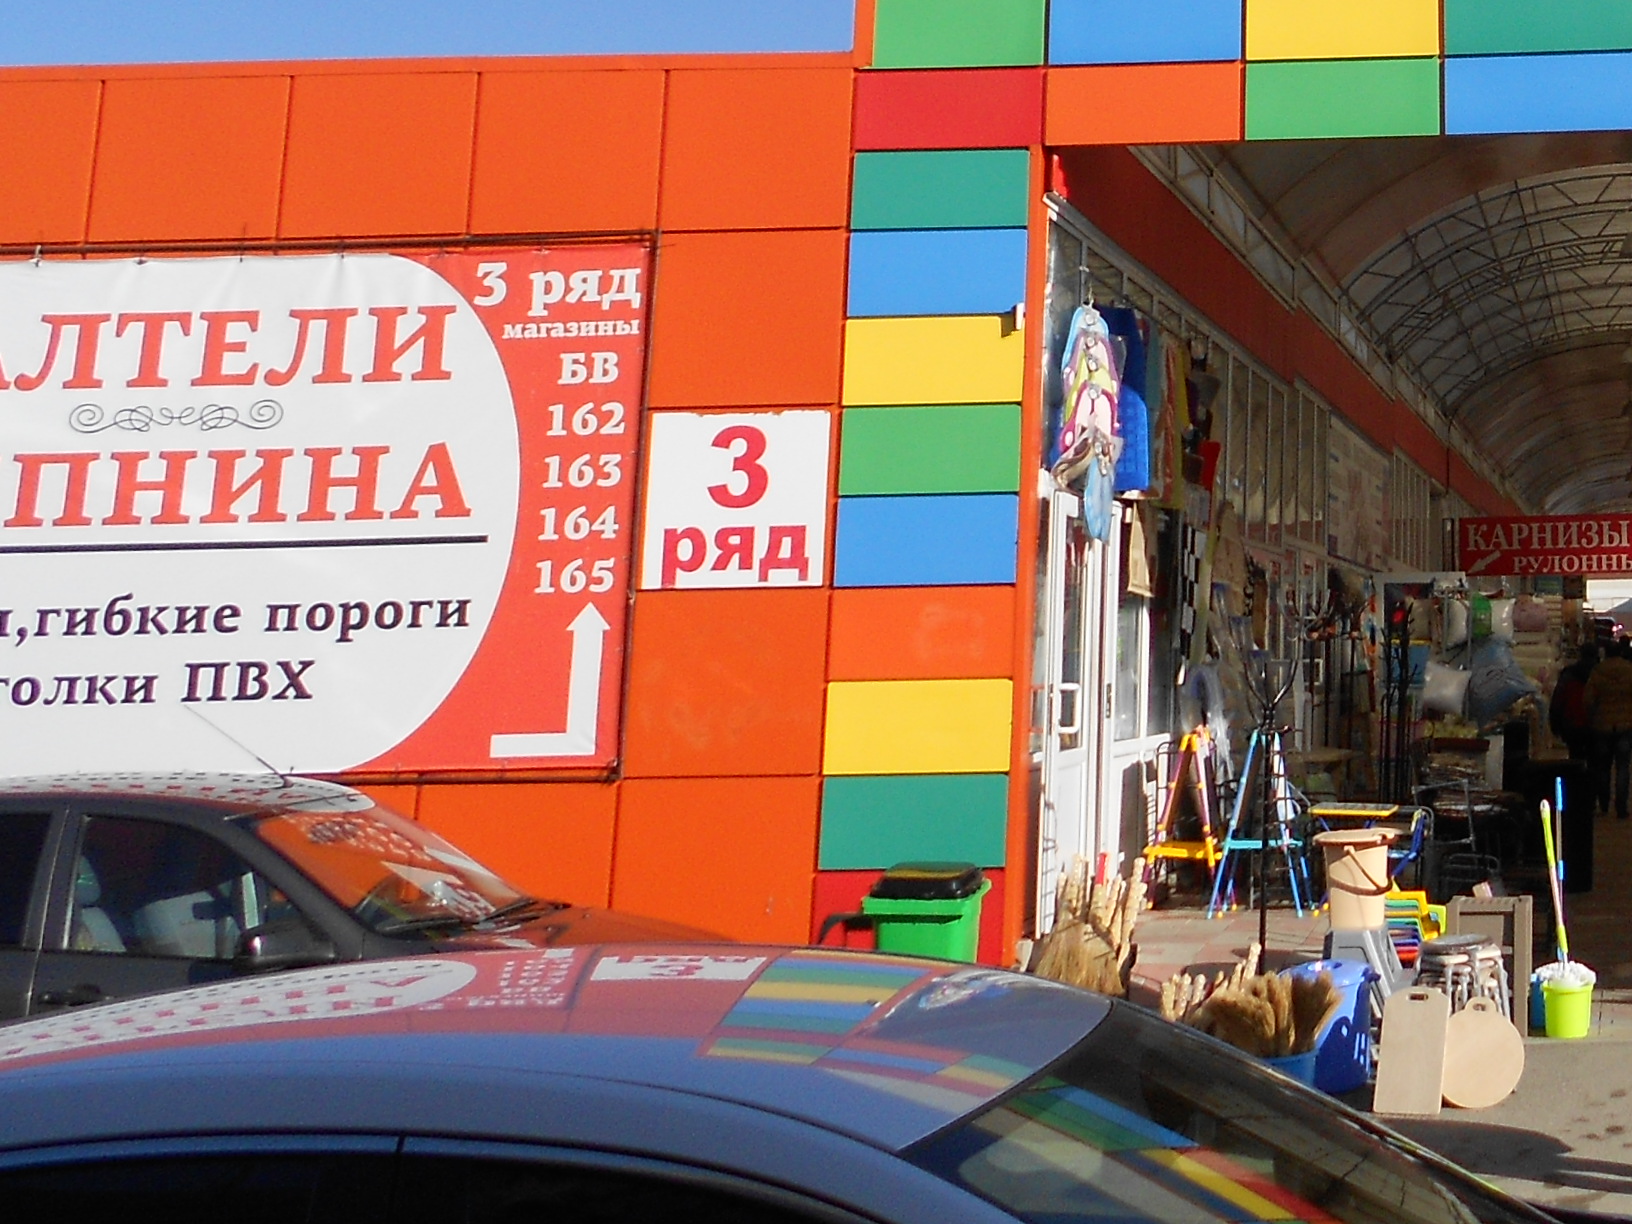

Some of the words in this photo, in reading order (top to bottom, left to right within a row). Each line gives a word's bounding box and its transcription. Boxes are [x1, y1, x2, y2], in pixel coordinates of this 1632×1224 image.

[473, 262, 506, 308] 3
[529, 266, 641, 317] ряд
[0, 305, 457, 390] ЛТЕЛИ
[502, 318, 640, 341] магазины
[558, 351, 620, 384] БВ
[546, 403, 625, 436] 162
[0, 441, 472, 529] ПНИНА
[543, 454, 622, 488] 163
[707, 425, 769, 508] 3
[537, 507, 619, 541] 164
[1466, 520, 1630, 551] КАРНИЗЫ
[661, 525, 809, 588] ряд
[534, 559, 615, 594] 165
[265, 596, 471, 644] пороги
[181, 660, 316, 703] ПВХ
